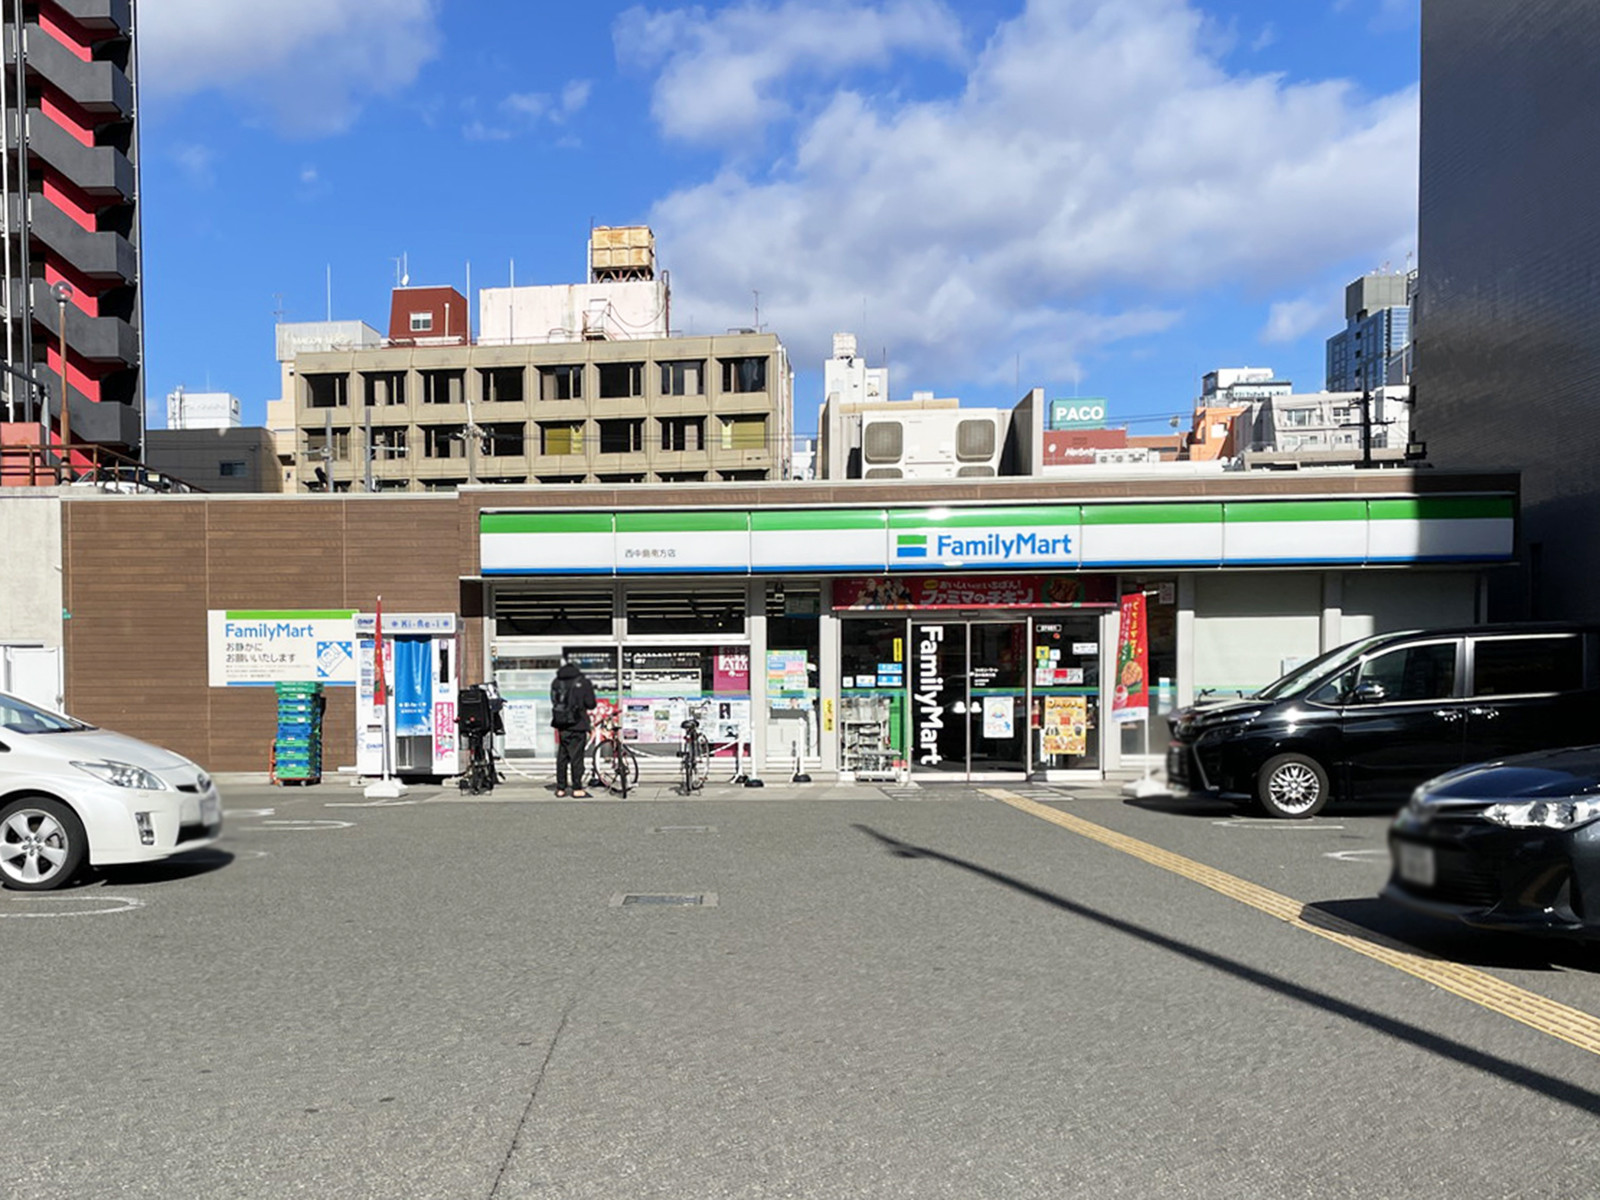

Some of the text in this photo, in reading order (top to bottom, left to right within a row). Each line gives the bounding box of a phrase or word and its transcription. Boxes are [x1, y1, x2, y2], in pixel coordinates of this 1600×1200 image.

[1056, 406, 1104, 421] PACO
[937, 533, 1072, 558] FamilyMart
[920, 588, 1033, 605] ファミマのチキン
[225, 623, 314, 641] FamilyMart
[226, 643, 263, 652] お静かに
[226, 653, 296, 663] お願いいたします
[723, 660, 749, 671] ATM
[914, 626, 944, 765] FamilyMart
